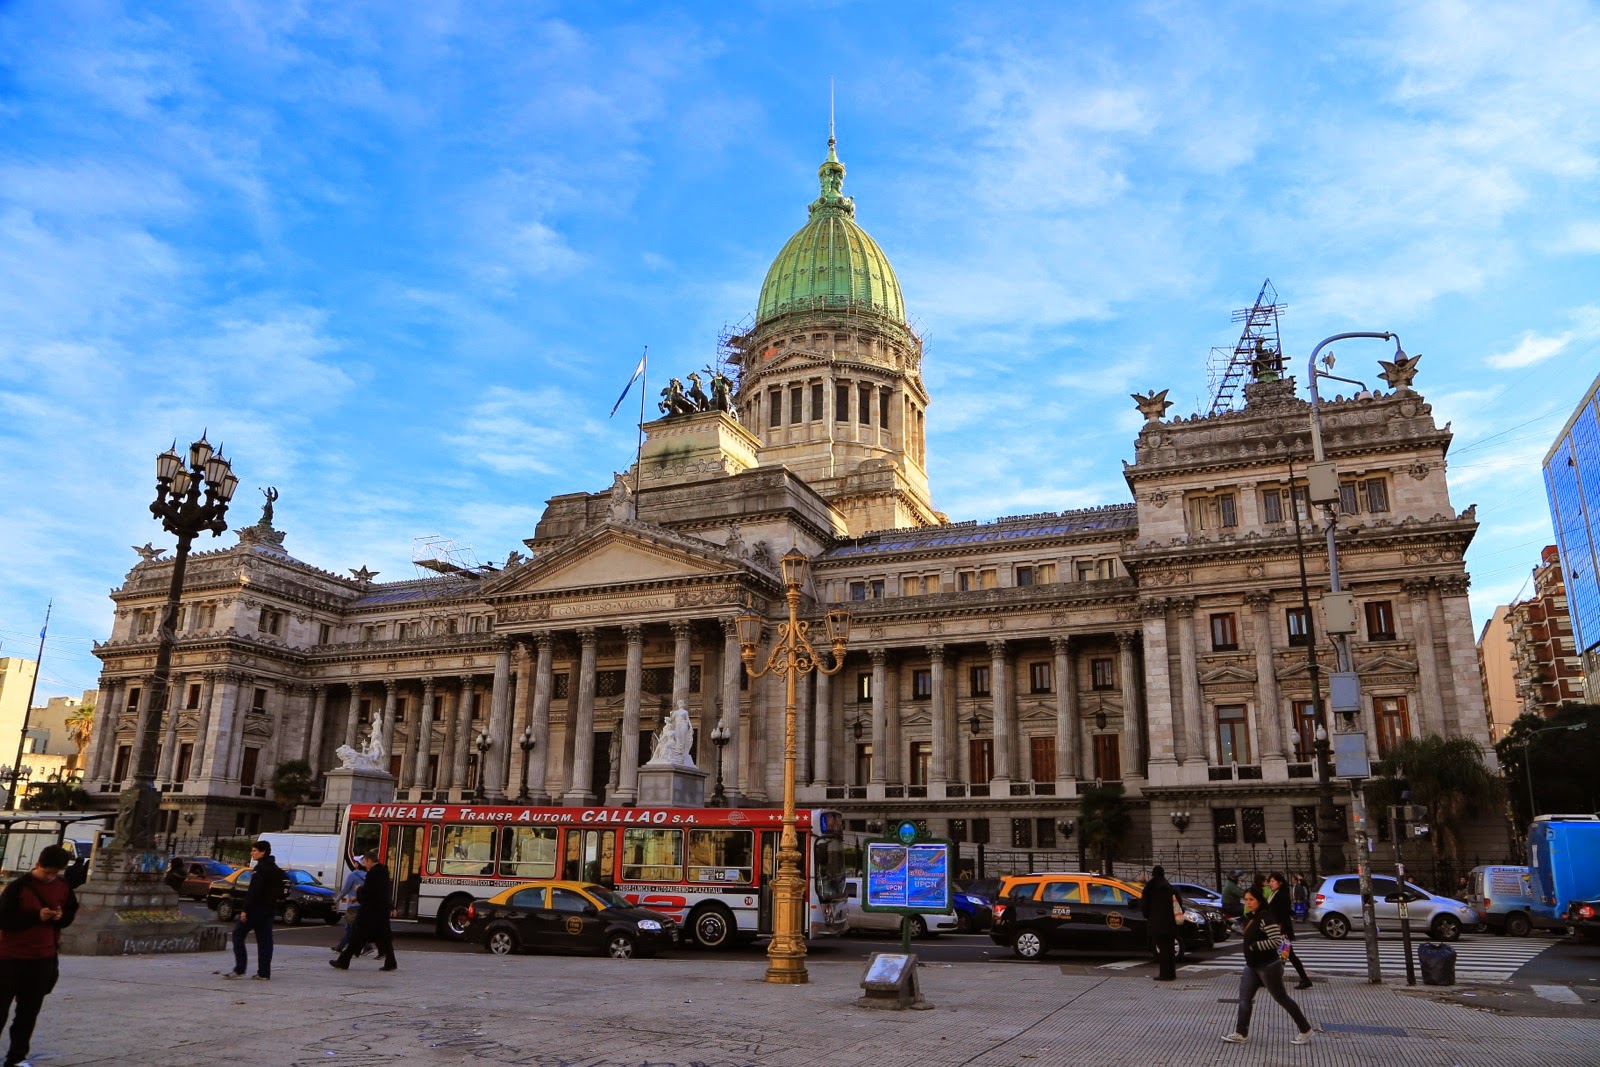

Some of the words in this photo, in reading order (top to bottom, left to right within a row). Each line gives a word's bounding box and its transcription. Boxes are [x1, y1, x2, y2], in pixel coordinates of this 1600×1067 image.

[559, 603, 612, 615] CONGRESO
[618, 598, 666, 610] NACIONAL
[368, 806, 417, 819] LINEA
[422, 807, 446, 819] 12
[581, 810, 667, 824] CALLAO
[914, 880, 937, 888] UPCN
